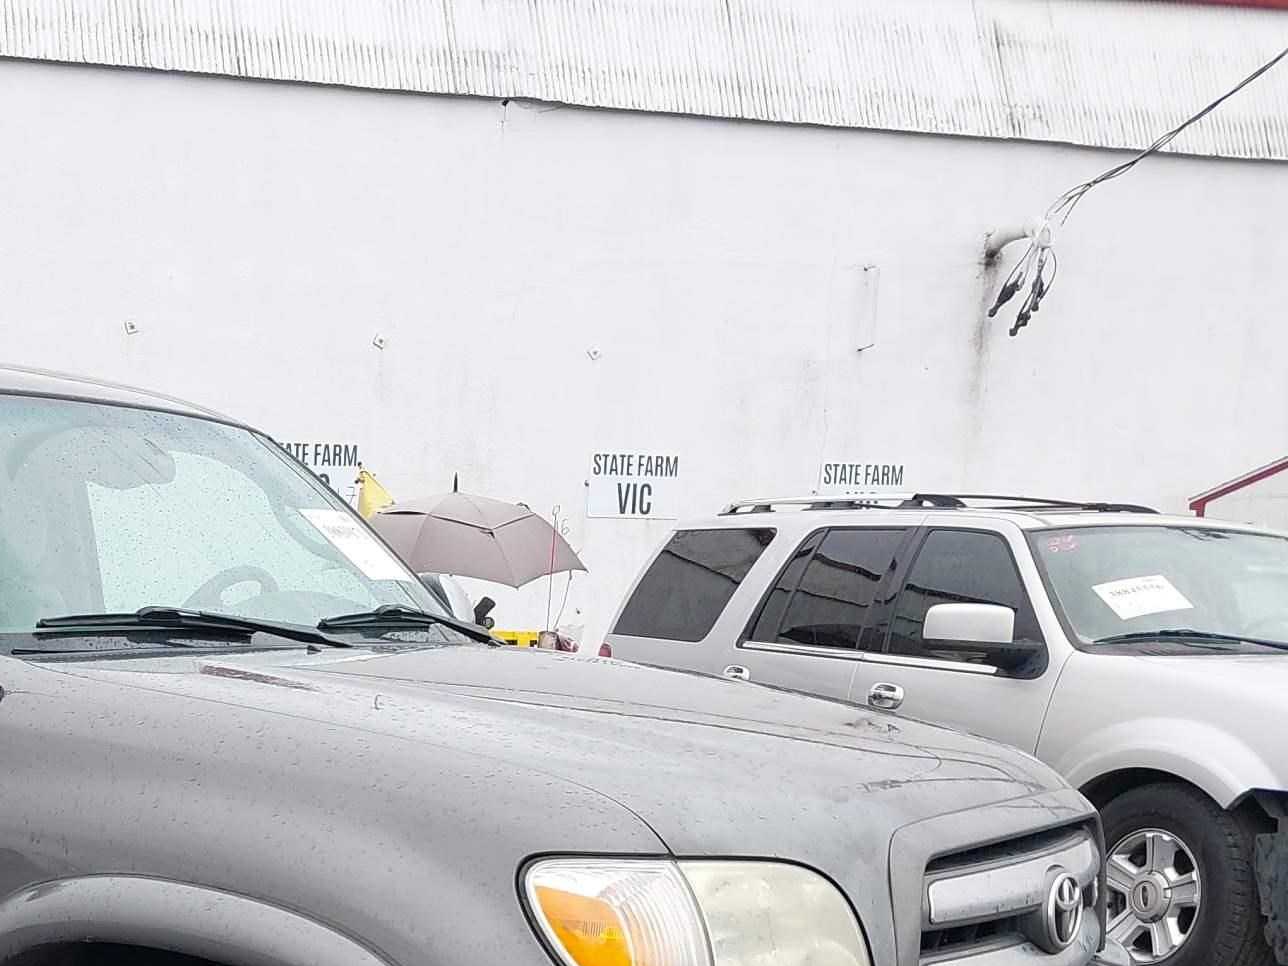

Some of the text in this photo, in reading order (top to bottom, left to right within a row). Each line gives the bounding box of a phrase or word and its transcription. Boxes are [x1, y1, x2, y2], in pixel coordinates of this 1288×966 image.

[313, 443, 358, 467] FARM
[592, 453, 679, 478] STATE FARM
[823, 463, 904, 486] STATE FARM
[617, 482, 653, 515] VIC
